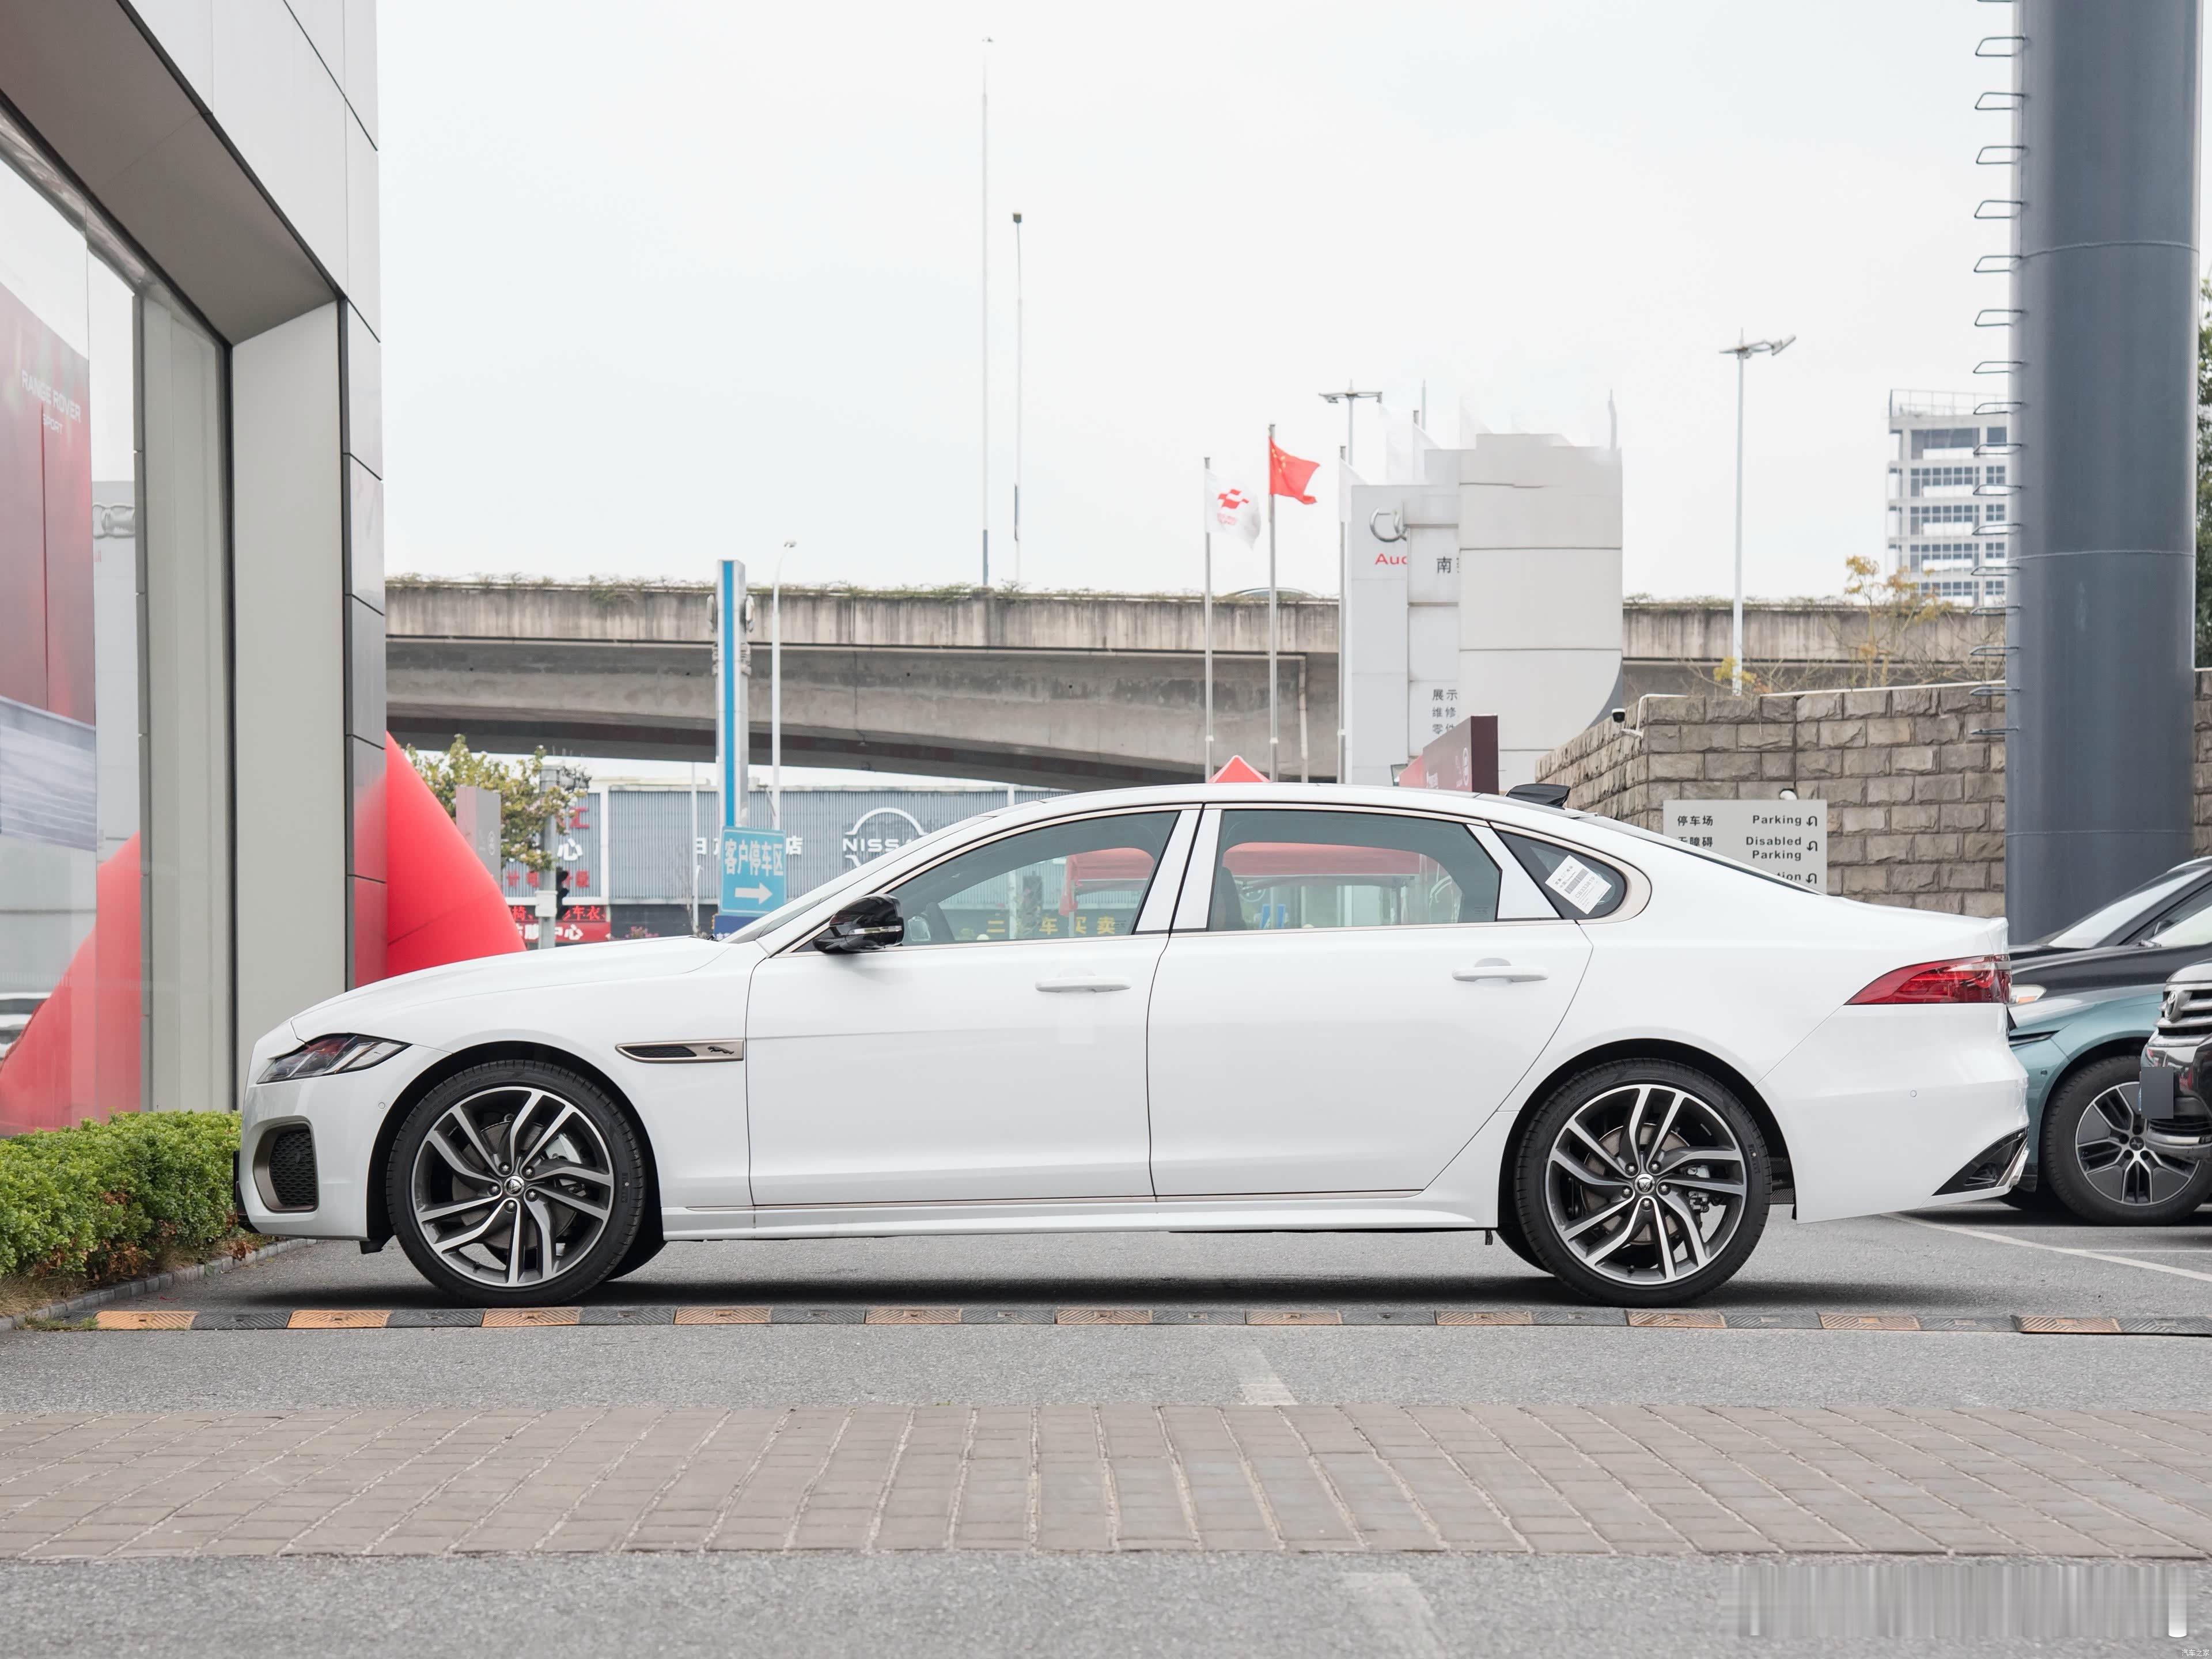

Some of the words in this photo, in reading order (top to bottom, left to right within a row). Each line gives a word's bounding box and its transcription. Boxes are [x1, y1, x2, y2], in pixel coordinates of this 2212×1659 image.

[22, 369, 52, 406] RANGE
[52, 389, 82, 424] ROVER
[43, 413, 63, 435] SPORT
[1437, 556, 1460, 574] 南
[1432, 689, 1457, 701] 展示
[1432, 707, 1457, 718] 维修
[1677, 815, 1713, 827] 停车场
[1752, 815, 1802, 826] Parking
[843, 838, 912, 853] NISS
[1746, 836, 1802, 846] Disabled
[724, 838, 784, 877] 客户停车区
[1752, 850, 1802, 861] Parking
[986, 916, 1116, 935] 二车买卖
